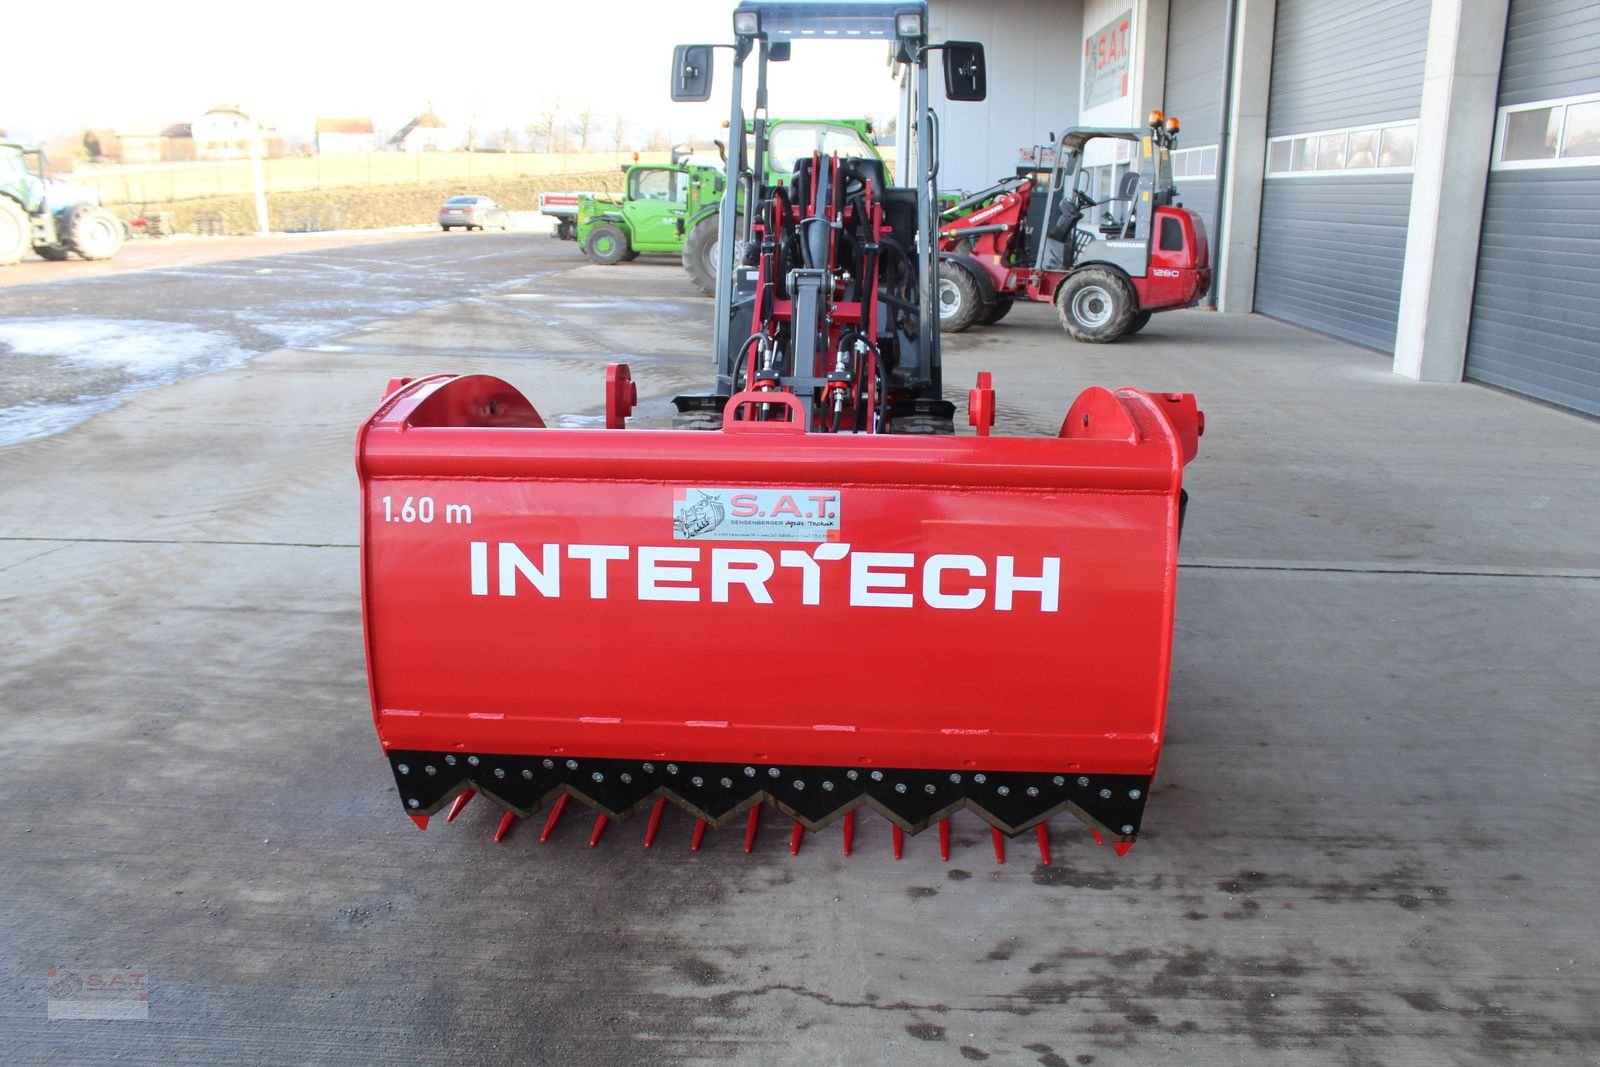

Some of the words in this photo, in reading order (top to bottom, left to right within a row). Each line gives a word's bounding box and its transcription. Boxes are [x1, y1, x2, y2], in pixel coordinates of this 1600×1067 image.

[383, 496, 434, 523] 1.60
[446, 504, 472, 524] m
[731, 493, 835, 518] S.A.T.
[471, 541, 1061, 612] INTERTECH
